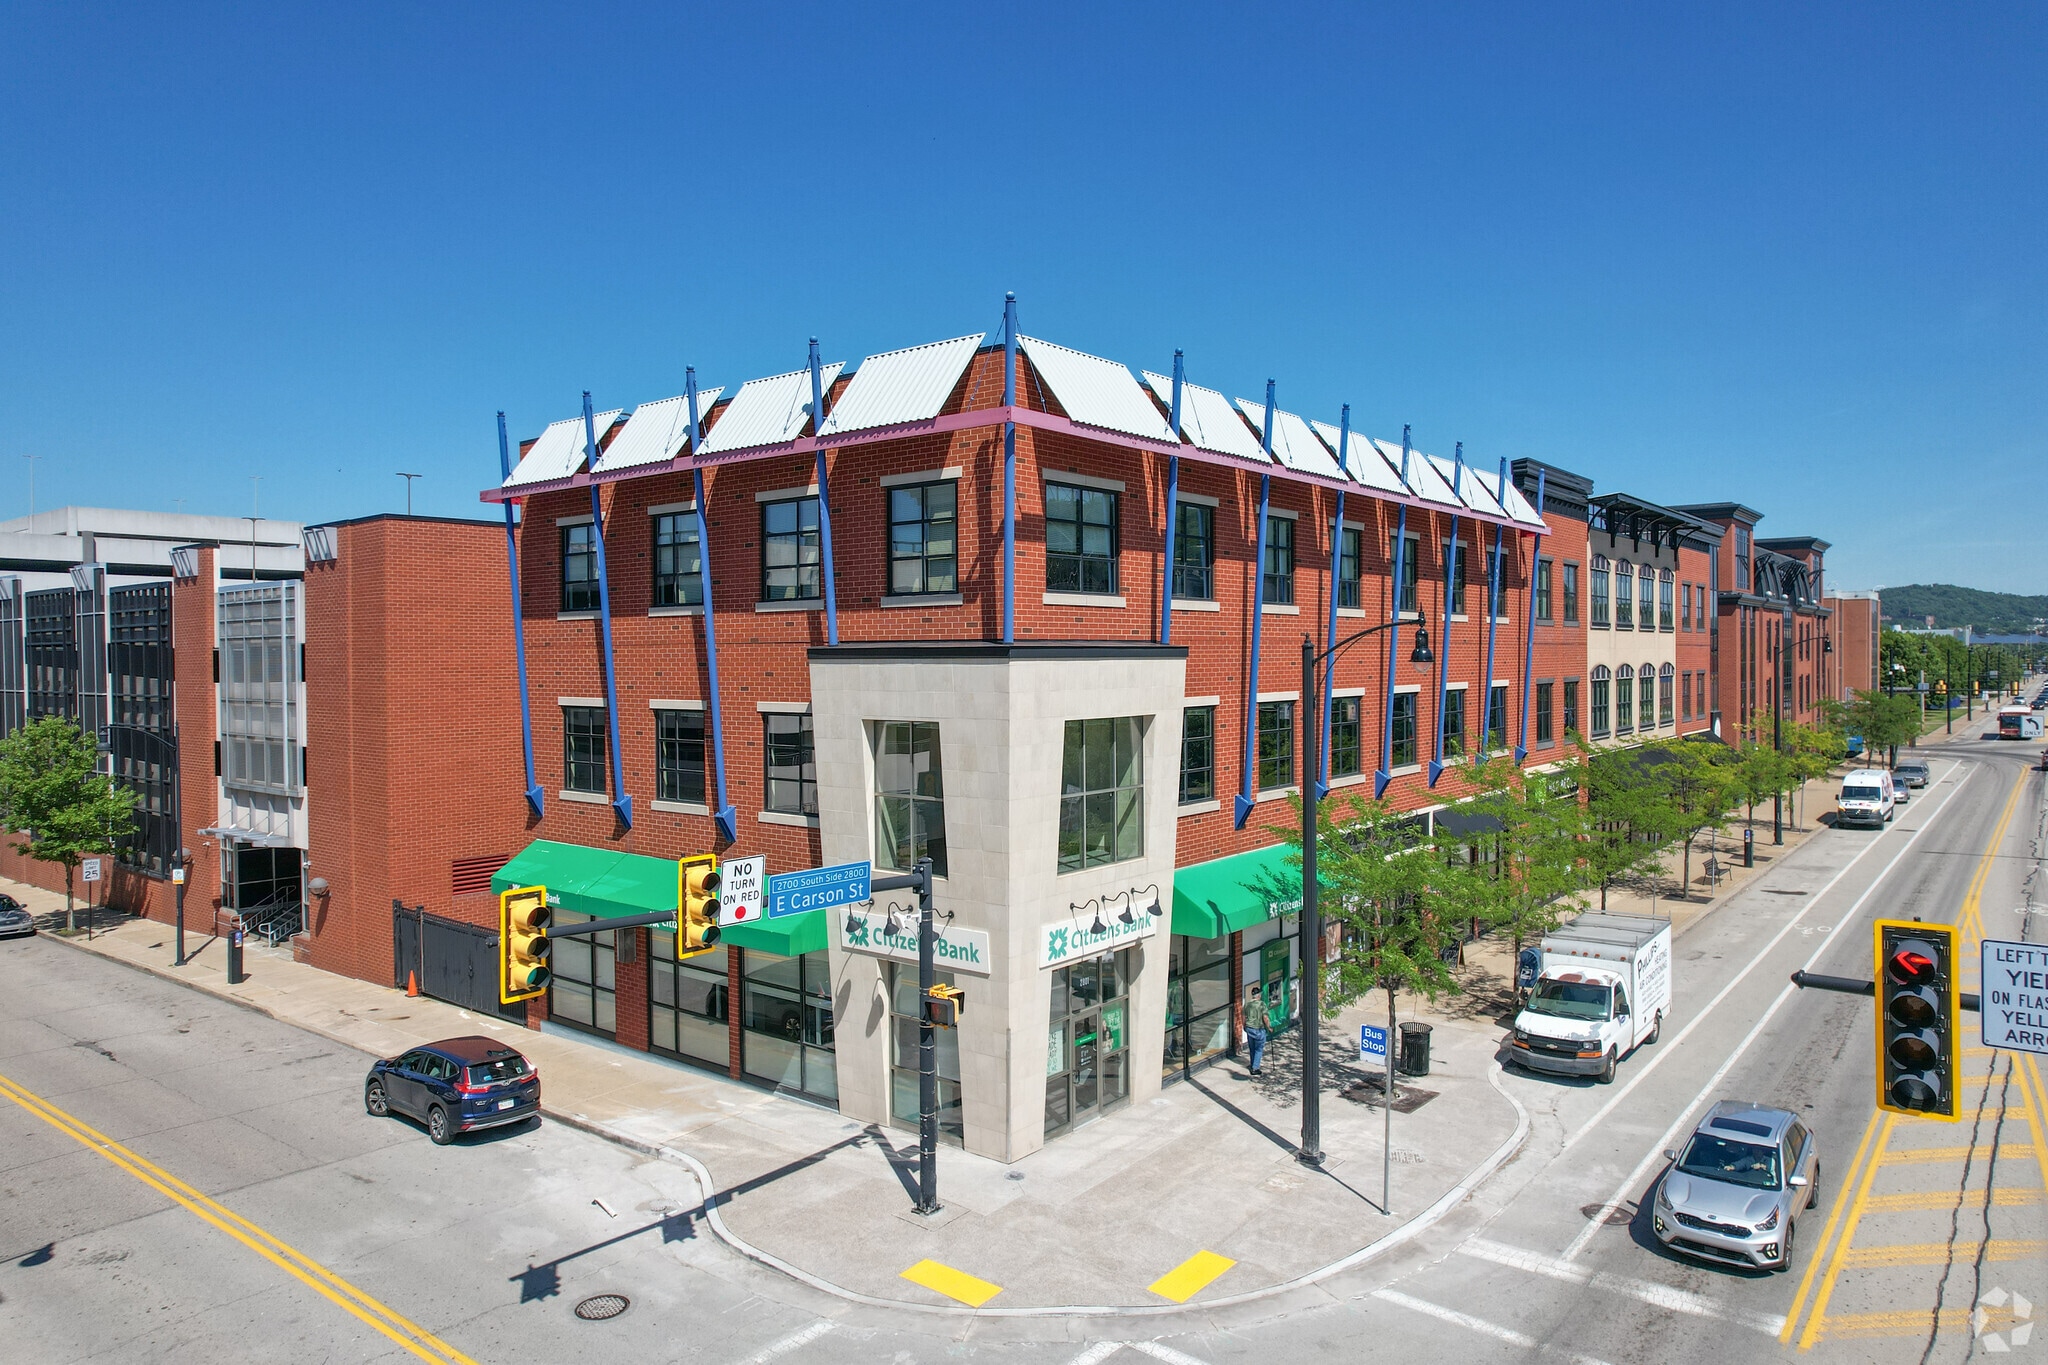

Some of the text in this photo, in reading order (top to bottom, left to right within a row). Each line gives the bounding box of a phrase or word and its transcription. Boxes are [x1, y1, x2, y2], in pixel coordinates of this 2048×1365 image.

[84, 870, 98, 879] 25
[733, 862, 752, 877] NO
[730, 878, 755, 891] TURN
[777, 869, 864, 891] 2700 South Side 2800
[723, 890, 760, 906] ON RED
[776, 883, 864, 912] E Carson St
[1279, 899, 1301, 912] Citizens
[1071, 911, 1152, 949] Citizens Bank
[938, 938, 980, 963] Bank
[1996, 948, 2034, 964] LEFT
[1992, 990, 2010, 1006] ON
[1364, 1028, 1383, 1040] Bus
[2005, 1029, 2048, 1047] ARR
[1362, 1039, 1385, 1053] Stop
